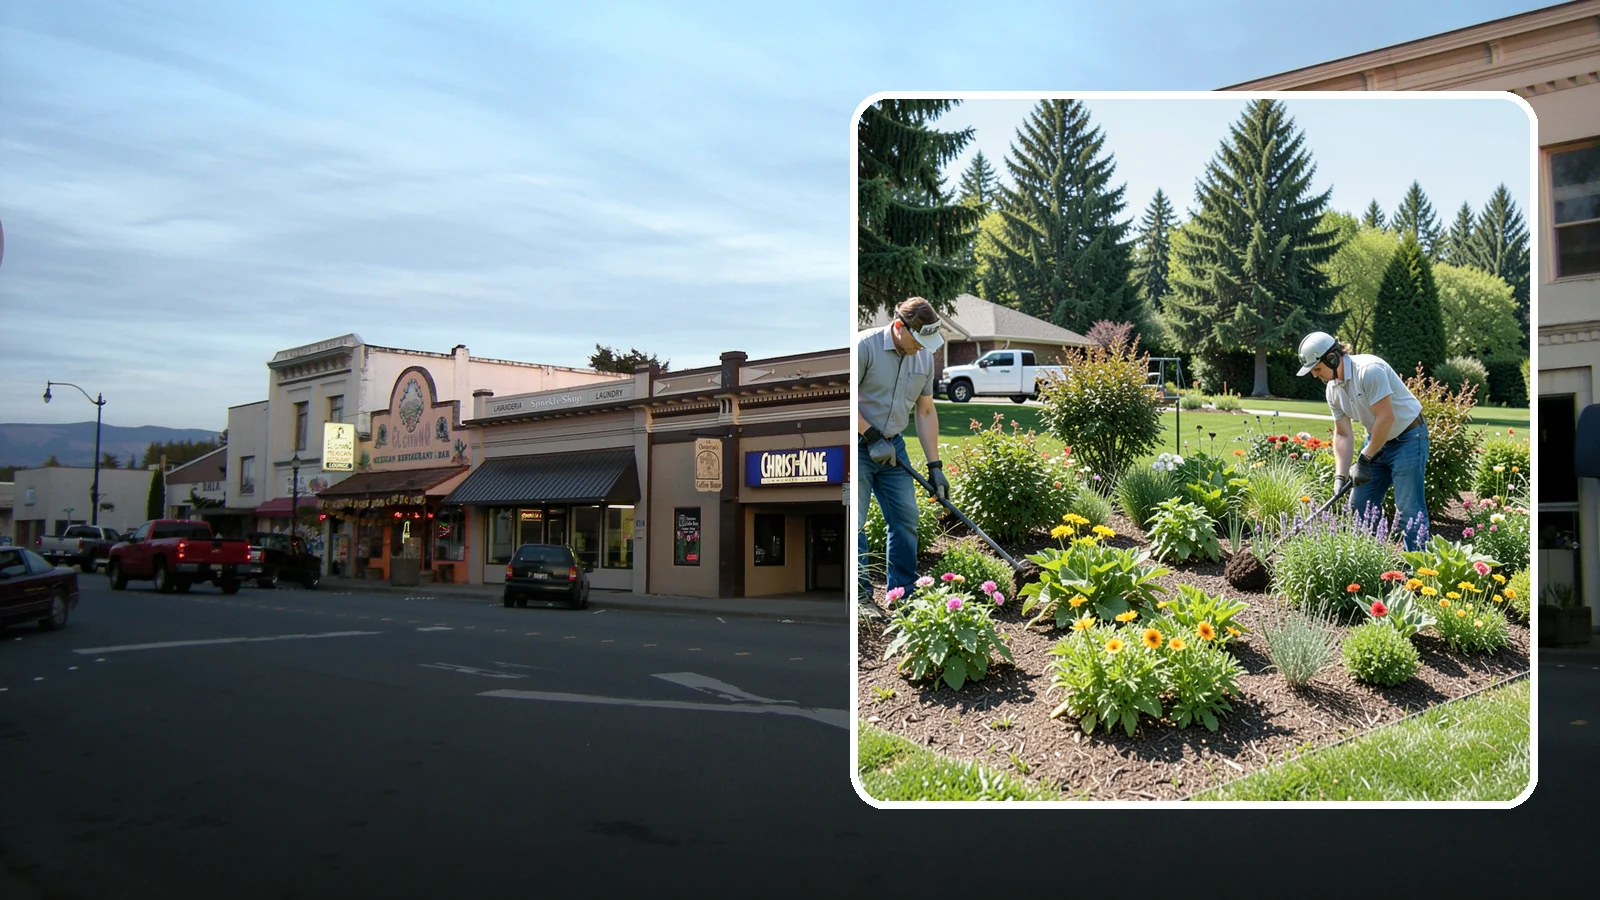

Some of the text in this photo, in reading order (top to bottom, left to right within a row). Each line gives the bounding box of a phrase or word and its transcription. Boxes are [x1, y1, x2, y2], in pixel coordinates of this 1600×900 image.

[595, 389, 623, 400] LAUNDRY
[493, 402, 522, 413] LAVANDERIA
[397, 451, 433, 463] RESTAURANT
[438, 450, 450, 459] BAR
[761, 452, 797, 478] CHRIST
[799, 450, 827, 476] KING
[697, 480, 709, 488] Coffee
